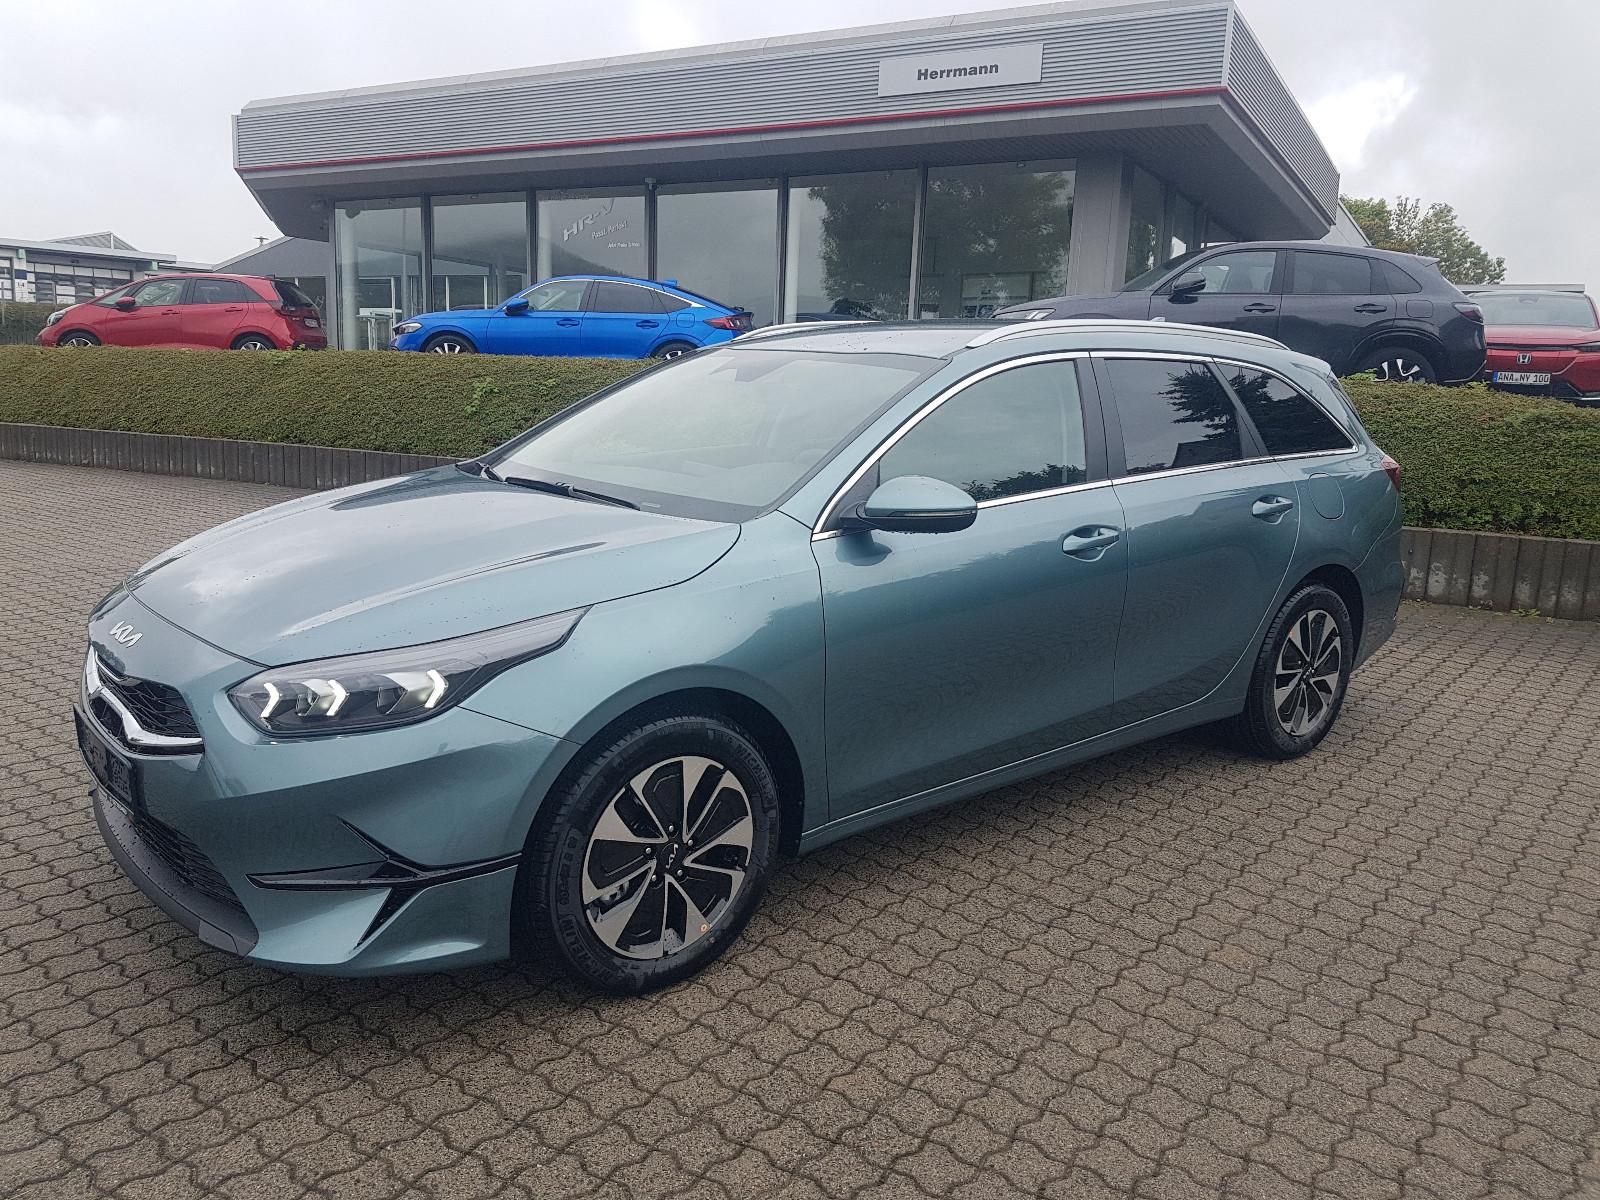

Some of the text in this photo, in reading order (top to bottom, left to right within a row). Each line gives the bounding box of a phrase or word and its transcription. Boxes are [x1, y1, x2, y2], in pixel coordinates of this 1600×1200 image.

[917, 63, 999, 81] Herrmann
[1498, 372, 1549, 383] ANA NY 100
[109, 620, 143, 648] KIA
